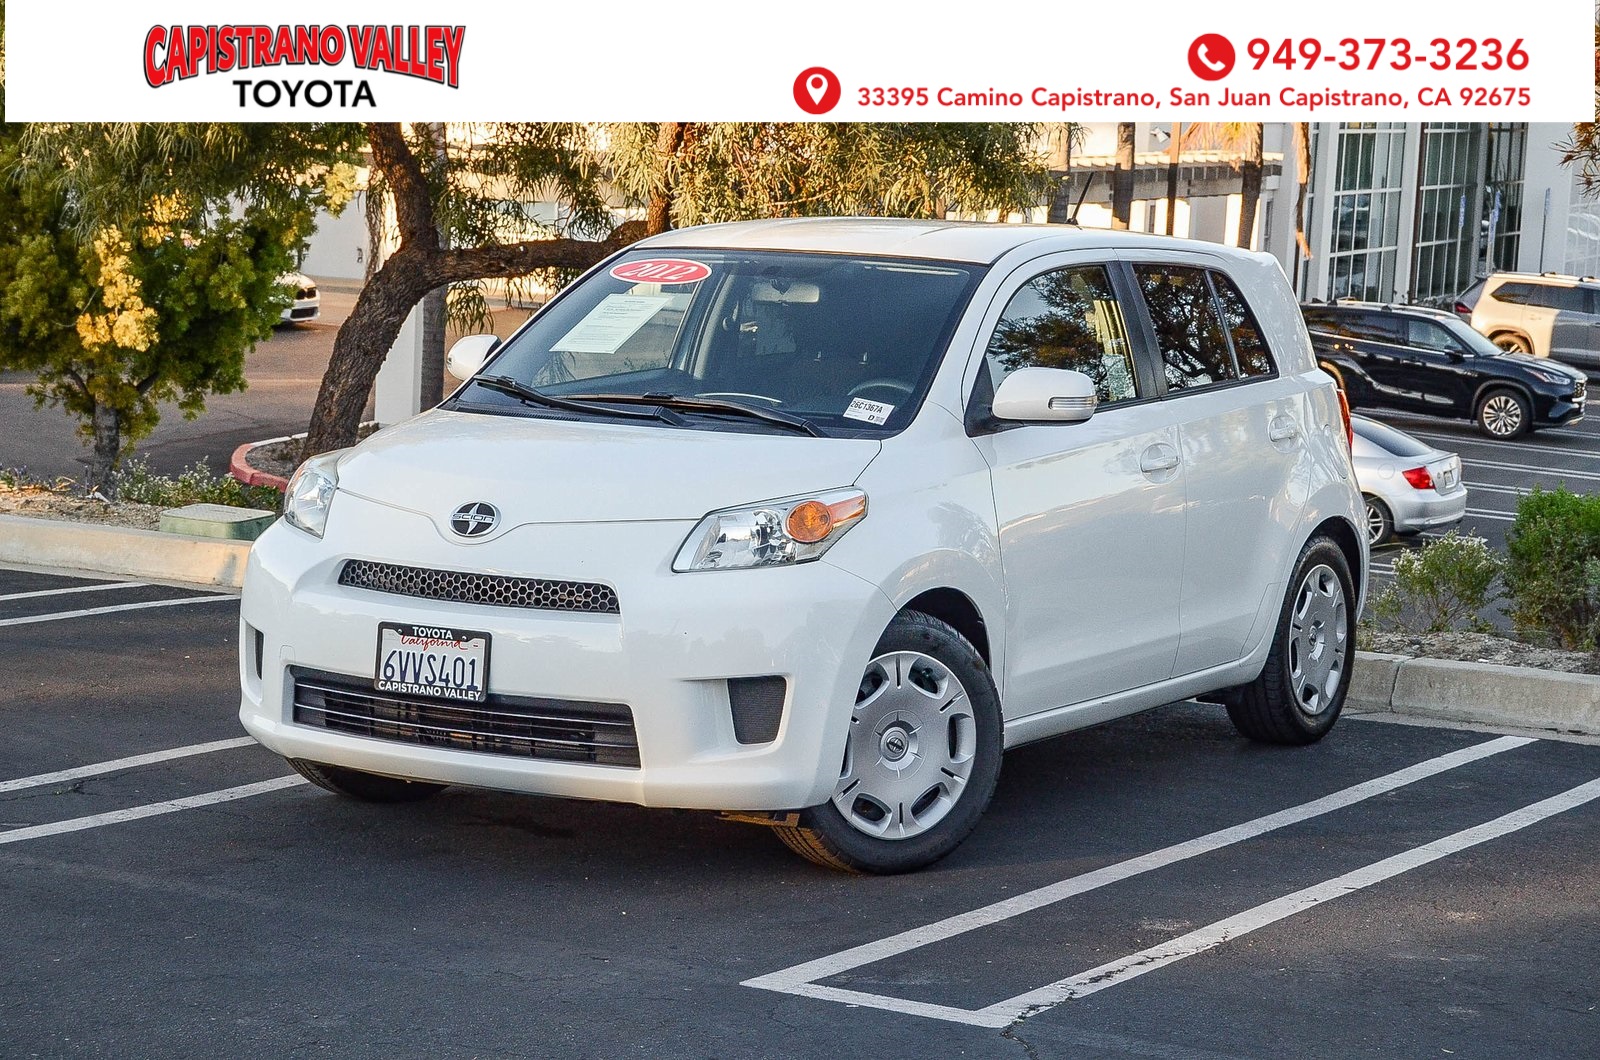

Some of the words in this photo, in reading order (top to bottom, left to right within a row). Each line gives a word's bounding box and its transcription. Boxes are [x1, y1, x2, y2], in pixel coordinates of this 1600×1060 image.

[620, 263, 698, 281] 2012
[412, 626, 454, 640] TOYOTA
[383, 650, 479, 691] 6VVS401
[378, 681, 441, 696] CAPISTRANO
[443, 687, 481, 701] VALLEY
